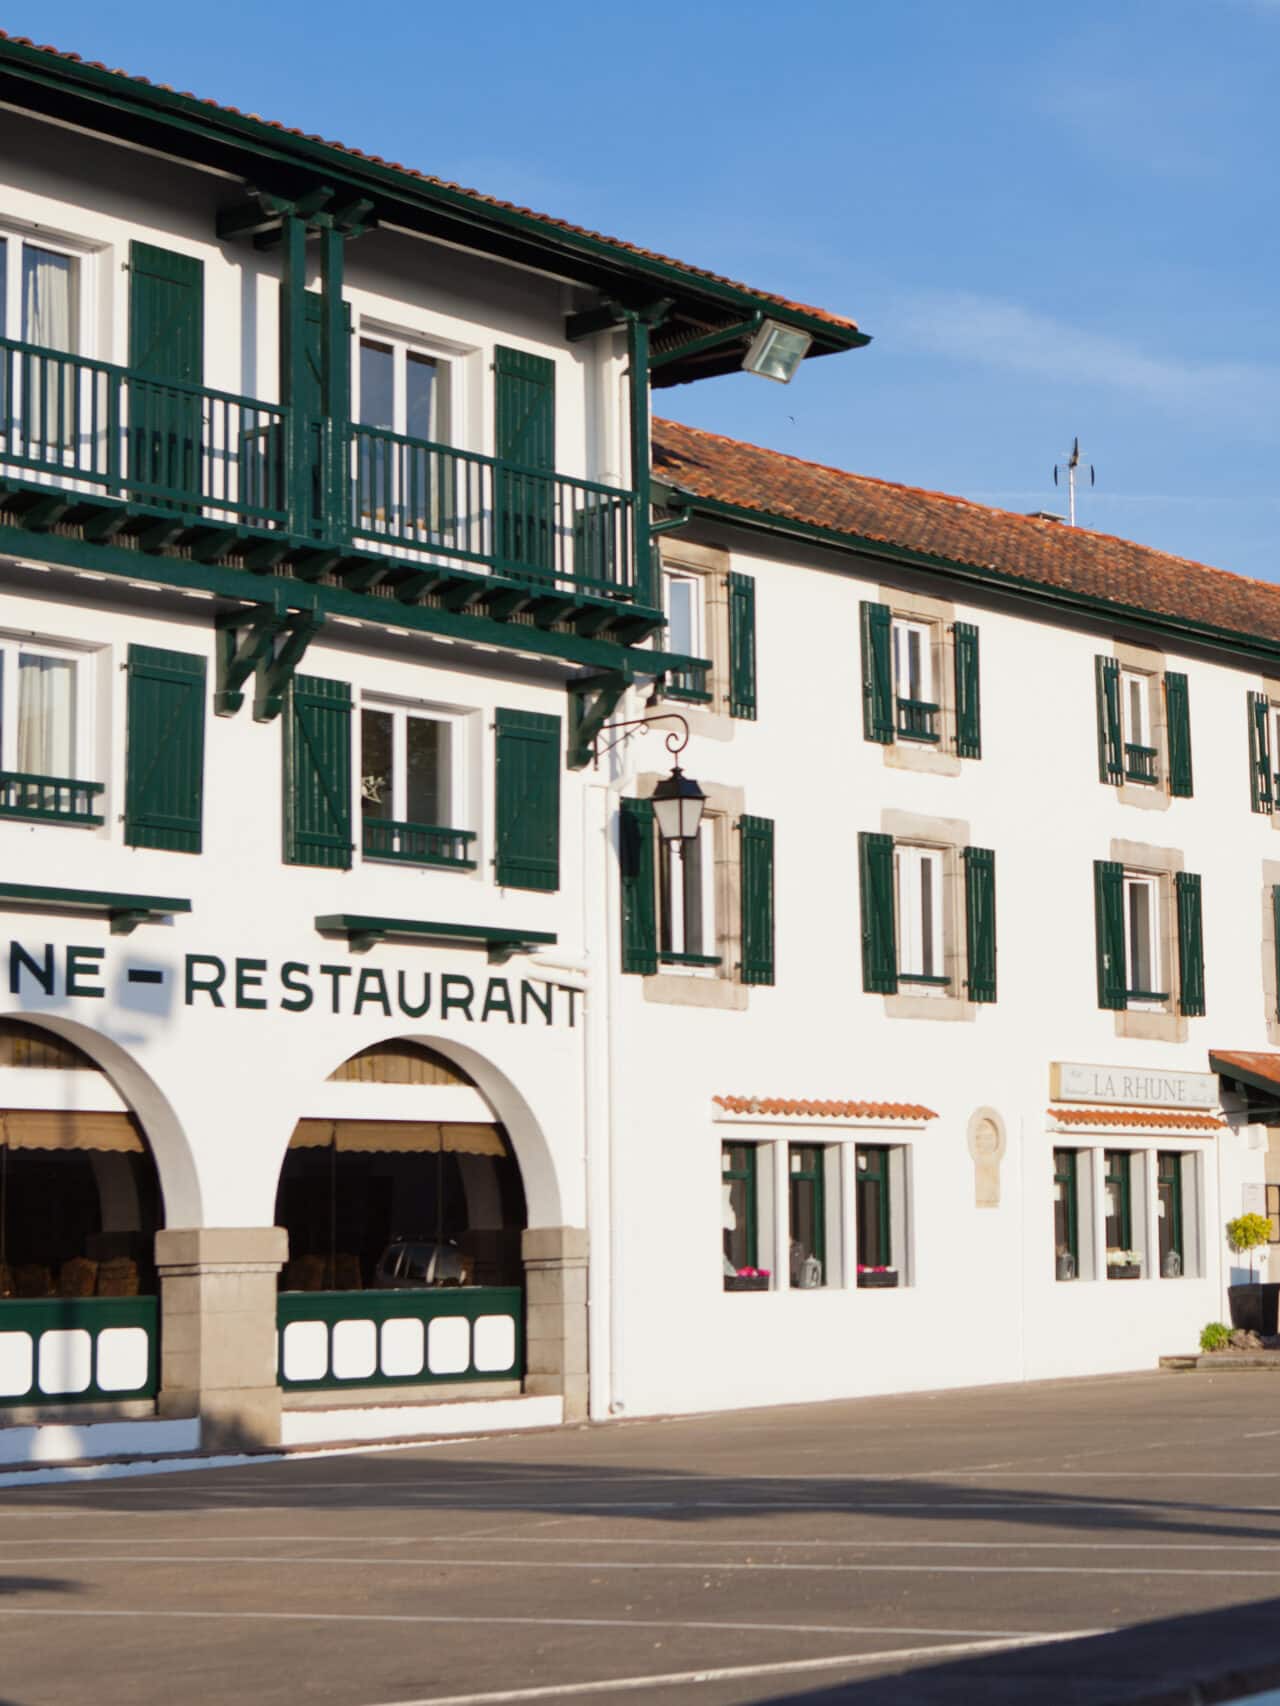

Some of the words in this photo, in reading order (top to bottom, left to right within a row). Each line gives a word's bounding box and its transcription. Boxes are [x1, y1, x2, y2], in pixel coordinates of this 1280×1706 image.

[9, 940, 105, 998] NE
[184, 953, 585, 1028] RESTAURANT
[1093, 1072, 1116, 1098] LA
[1122, 1075, 1186, 1101] RHUNE
